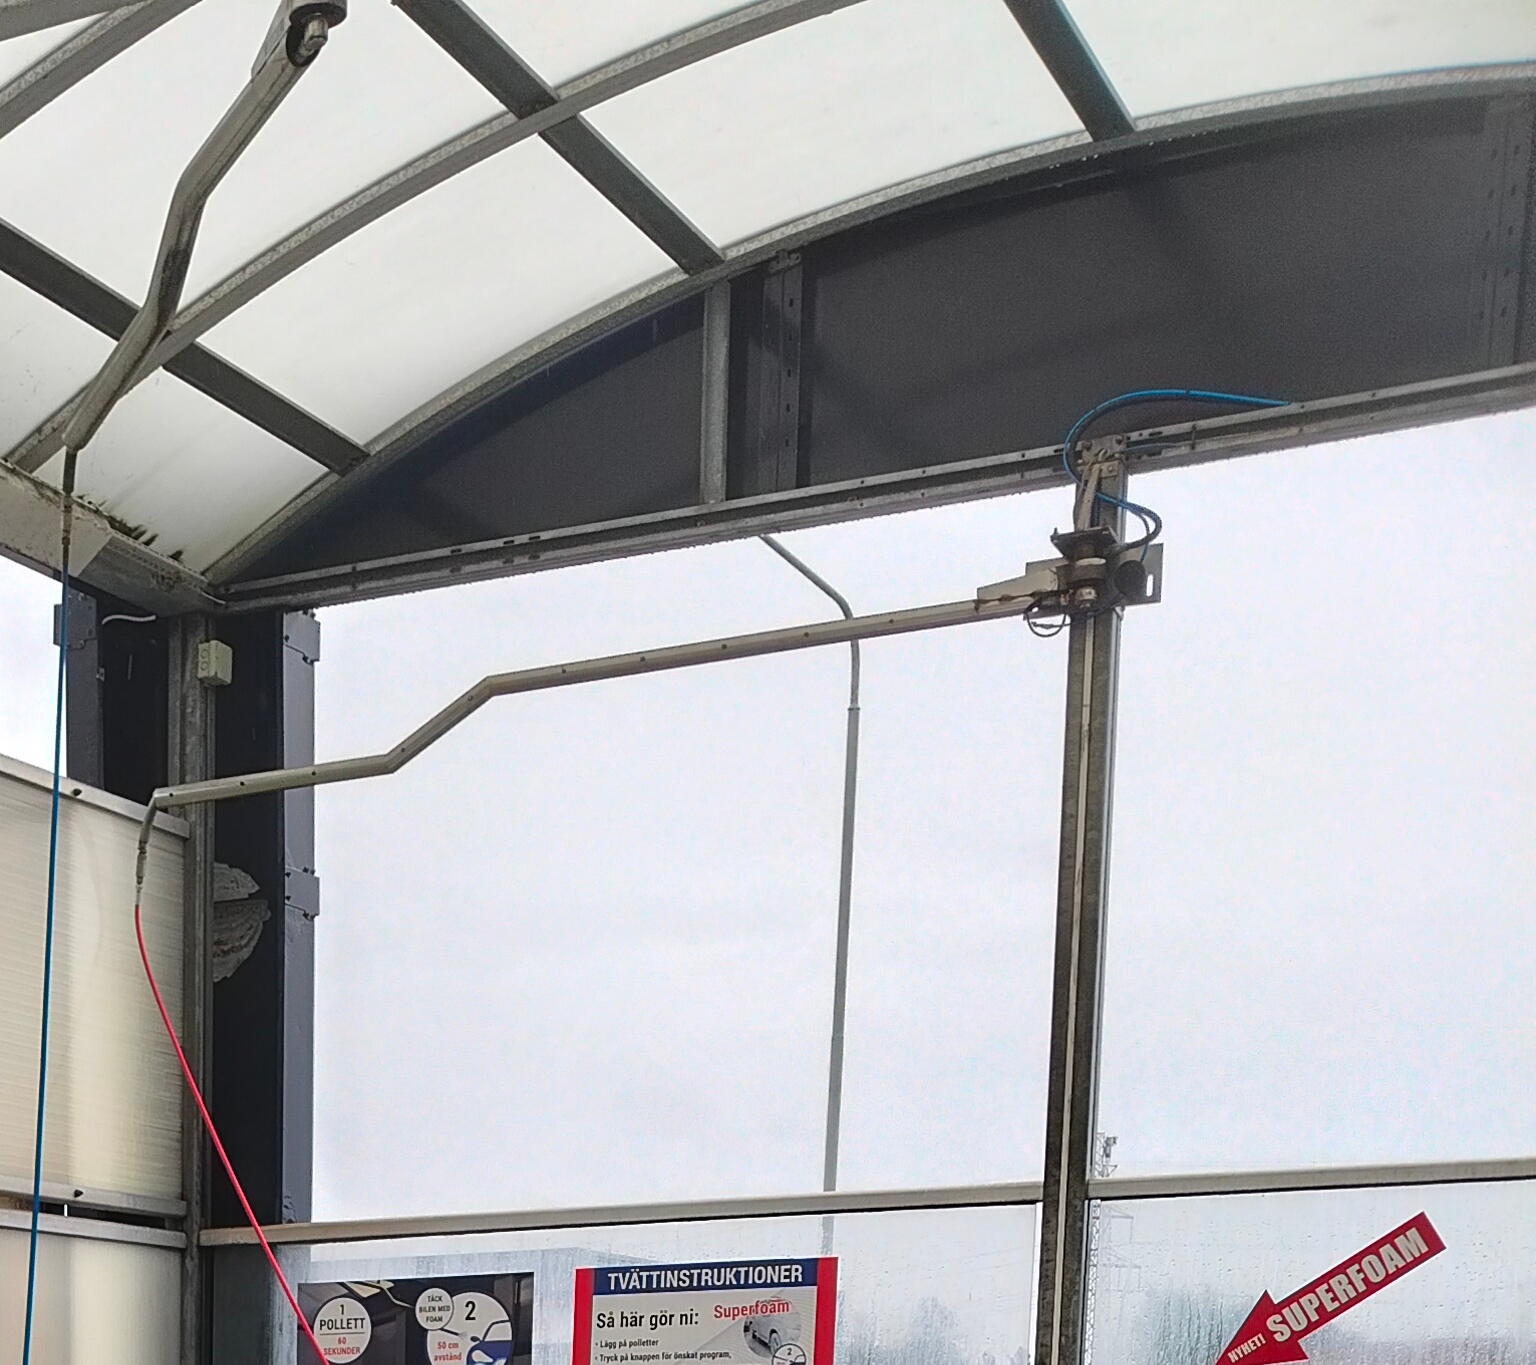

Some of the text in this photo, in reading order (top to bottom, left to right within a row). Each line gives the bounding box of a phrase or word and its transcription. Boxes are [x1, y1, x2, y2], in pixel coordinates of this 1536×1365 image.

[607, 1265, 803, 1291] TVÄTTINSTRUKTIONER
[1266, 1227, 1429, 1342] SUPERFOAM
[419, 1305, 437, 1314] BILEN
[465, 1300, 476, 1321] 2
[714, 1300, 790, 1321] Superfoam
[319, 1317, 366, 1331] POLLETT
[426, 1315, 443, 1323] FOAM
[596, 1308, 699, 1330] Så här gör ni:
[337, 1336, 347, 1345] 60
[437, 1341, 459, 1350] 50 cm
[600, 1337, 659, 1349] Lägg på polletter
[323, 1346, 361, 1355] SEKUNDER
[1227, 1333, 1266, 1364] NYHET!
[434, 1351, 462, 1362] avstånd
[600, 1353, 619, 1362] Tryck
[620, 1352, 629, 1362] på
[630, 1351, 660, 1362] knappen
[661, 1351, 672, 1360] för
[673, 1350, 698, 1360] önskat
